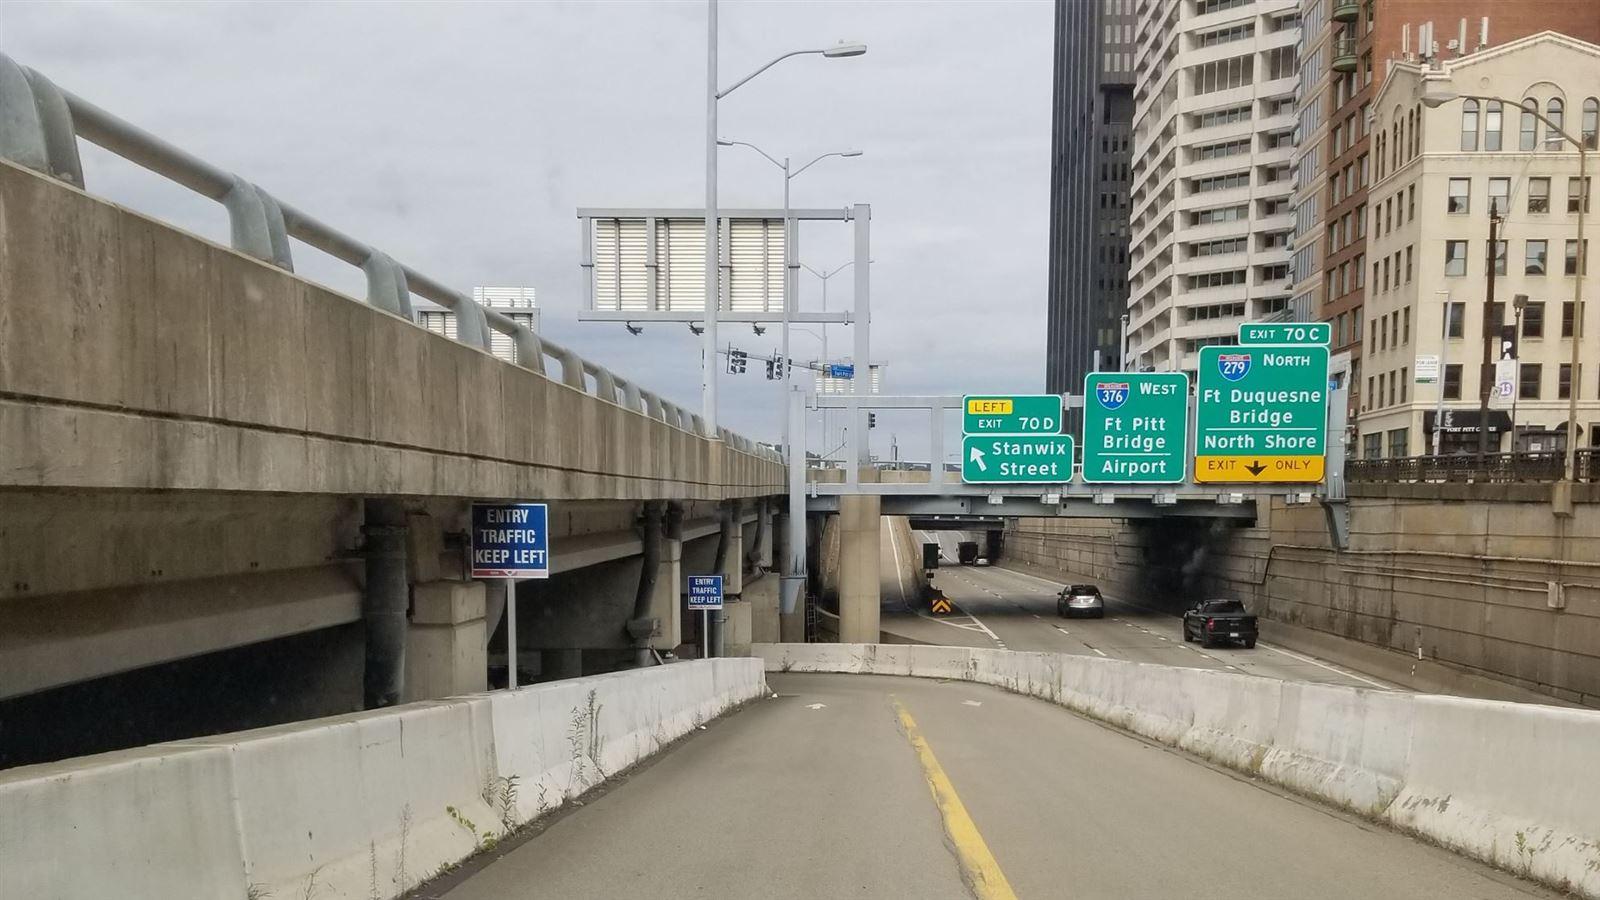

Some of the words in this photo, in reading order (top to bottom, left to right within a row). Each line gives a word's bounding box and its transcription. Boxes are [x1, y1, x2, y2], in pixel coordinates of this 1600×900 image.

[1250, 330, 1274, 338] EXIT
[1224, 362, 1245, 374] 279
[1264, 354, 1309, 366] NORTH
[1102, 390, 1123, 402] 376
[1140, 383, 1176, 394] WEST
[1205, 390, 1220, 402] Ft
[1231, 390, 1320, 405] Duquesne
[975, 403, 1006, 412] LEFT
[979, 420, 1001, 428] EXIT
[1105, 418, 1121, 430] Ft
[1133, 417, 1165, 430] Pitt
[1231, 410, 1292, 426] Bridge
[1104, 435, 1165, 452] Bridge
[1205, 435, 1254, 448] North
[1265, 435, 1316, 448] Shore
[993, 442, 1065, 455] Stanwix
[1001, 463, 1057, 475] Street
[1102, 460, 1165, 476] Airport
[1209, 460, 1236, 470] EXIT
[1276, 458, 1310, 469] ONLY
[487, 509, 529, 523] ENTRY
[481, 530, 535, 543] TRAFFIC
[476, 550, 509, 563] KEEP
[514, 550, 545, 564] LEFT
